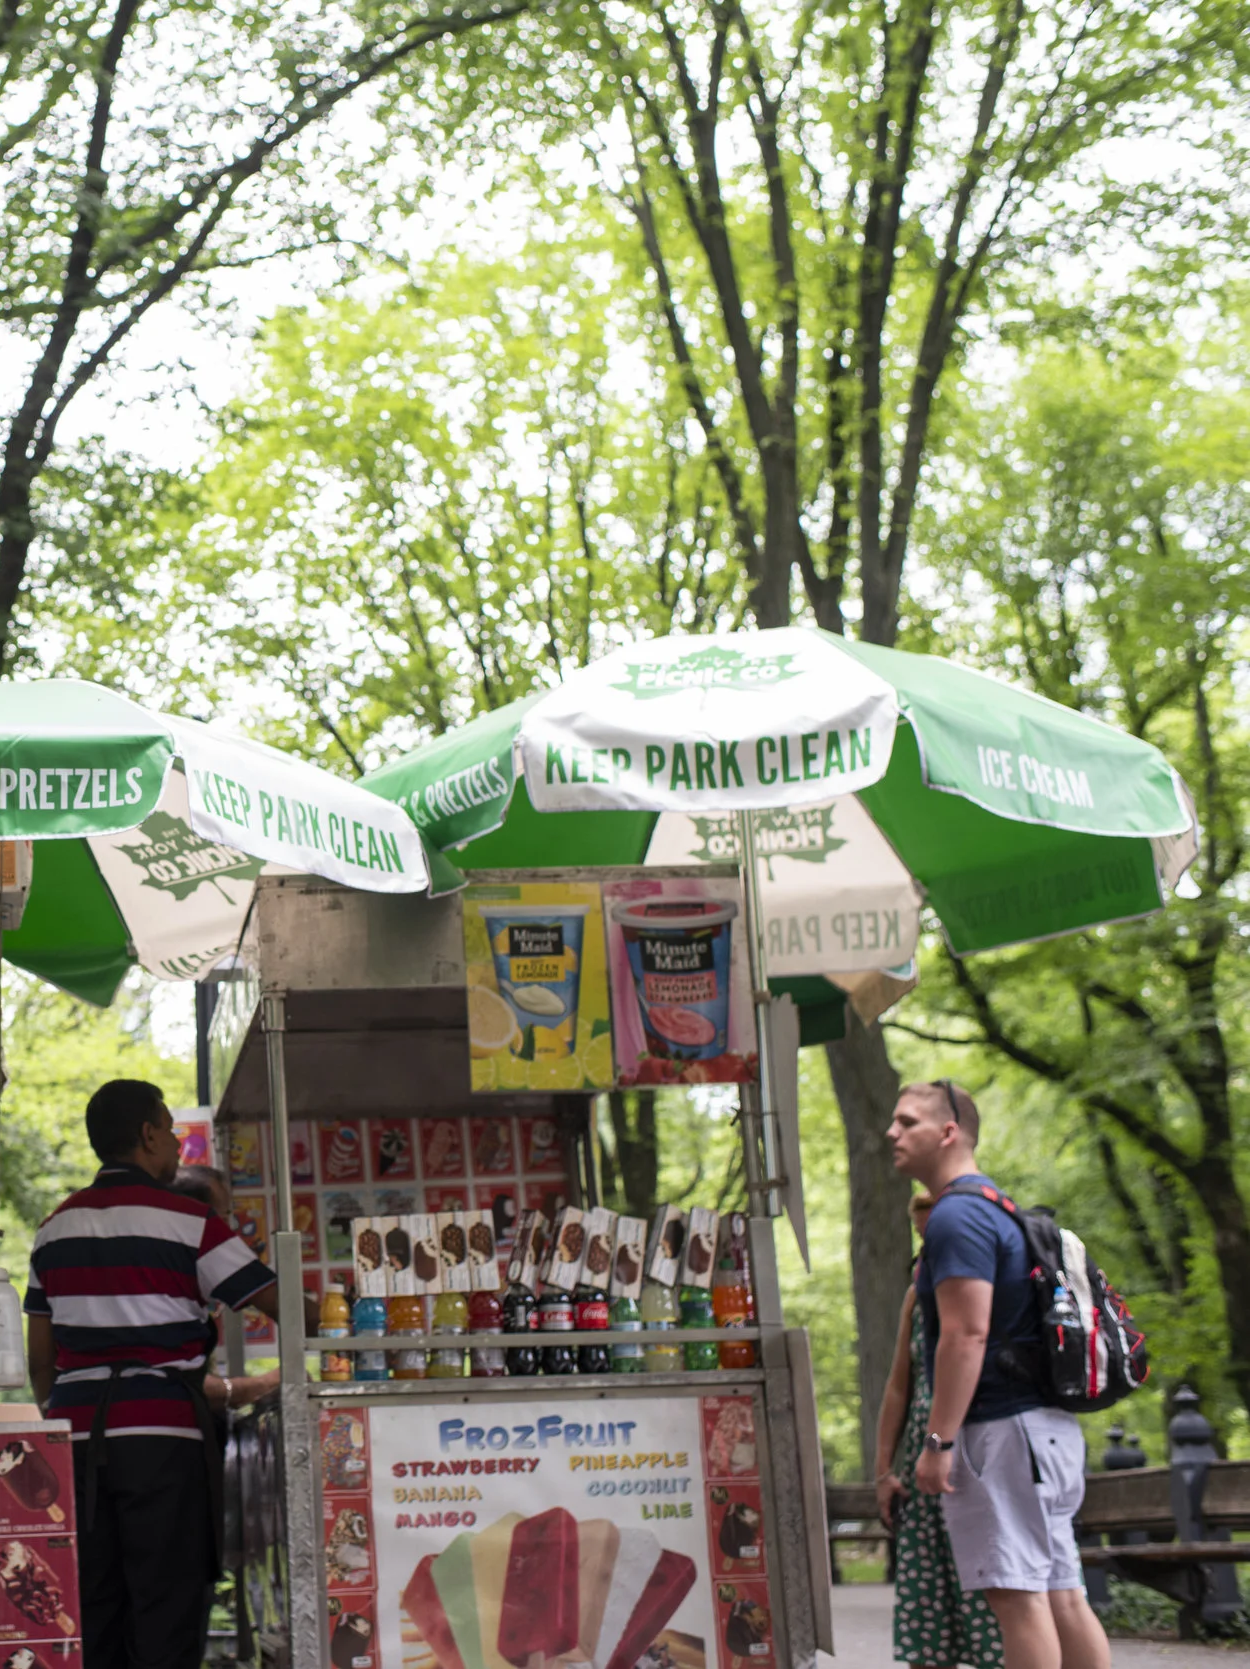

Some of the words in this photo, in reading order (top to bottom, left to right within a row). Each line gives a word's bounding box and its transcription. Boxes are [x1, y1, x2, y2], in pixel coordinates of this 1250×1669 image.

[739, 665, 781, 682] CO
[545, 741, 631, 785] KEEP
[645, 740, 744, 791] PARK
[756, 727, 872, 786] CLEAN
[977, 745, 1017, 791] ICE
[1018, 754, 1094, 809] CREAM
[0, 767, 143, 810] PRETZELS
[411, 791, 431, 827] &
[425, 756, 509, 821] PRETZELS
[194, 769, 250, 828] KEEP
[259, 790, 326, 851] PARK
[329, 812, 404, 873] CLEAN
[513, 929, 559, 942] Minute
[520, 941, 554, 953] Maid
[645, 940, 707, 955] Minute
[654, 955, 701, 969] Maid
[391, 1458, 541, 1478] STRAWBERRY
[569, 1452, 688, 1471] PINEAPPLE
[392, 1485, 482, 1504] BANANA
[587, 1477, 692, 1497] COCONUT
[395, 1510, 477, 1529] MANGO
[640, 1503, 694, 1520] LIME
